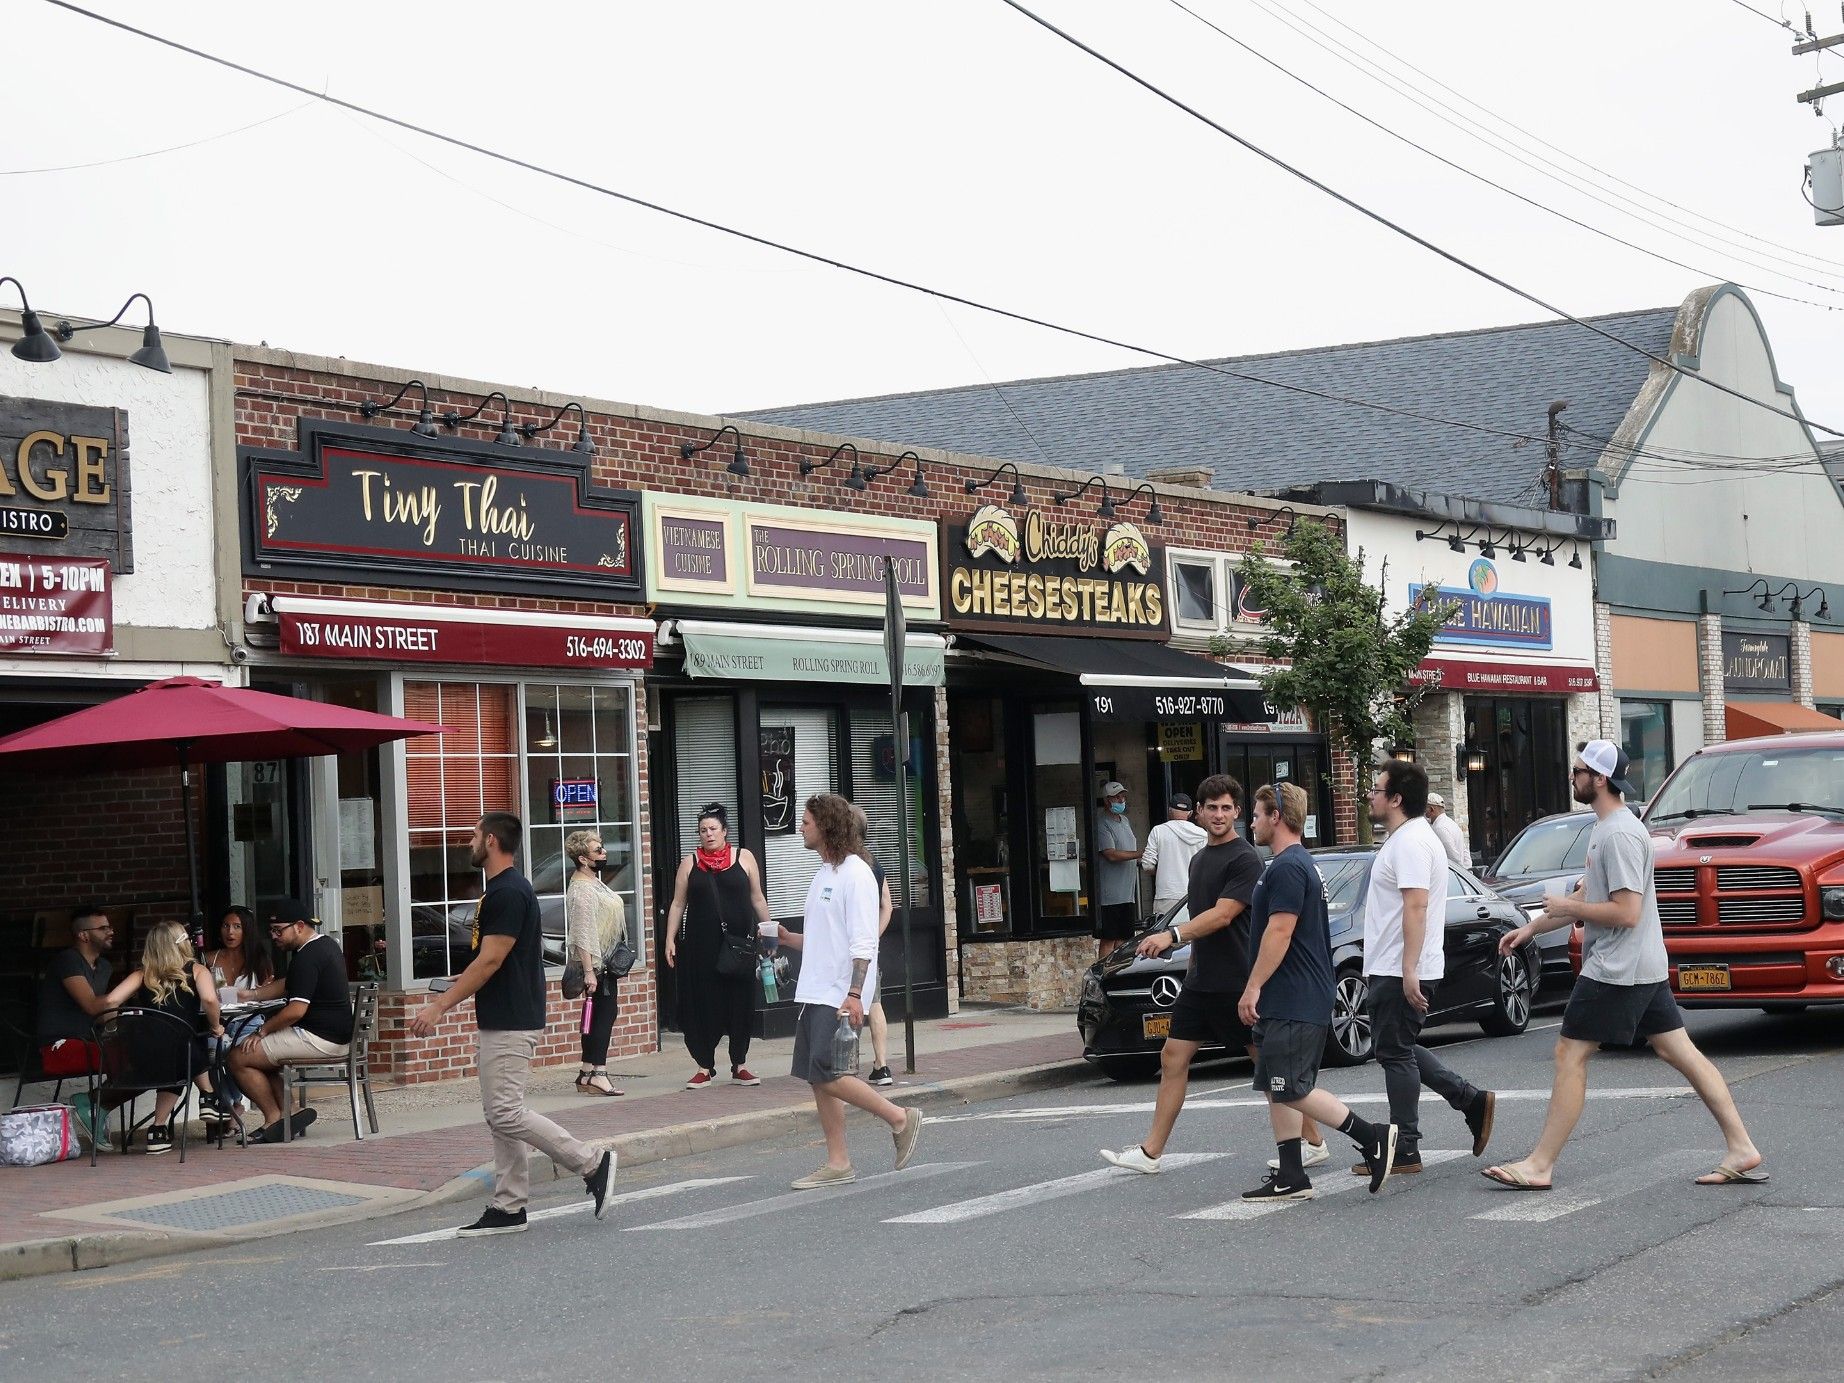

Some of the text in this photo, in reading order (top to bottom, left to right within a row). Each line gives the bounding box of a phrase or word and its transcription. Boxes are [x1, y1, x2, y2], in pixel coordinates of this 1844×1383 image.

[351, 470, 534, 546] Tiny Thai
[663, 525, 721, 550] VIETNAMESE
[754, 529, 769, 543] THE
[1025, 508, 1099, 573] Chiddy's
[459, 538, 568, 564] THAI CUISINE
[675, 553, 712, 575] CUISINE
[756, 545, 825, 577] ROLLING
[831, 551, 883, 582] SPRING
[41, 565, 105, 592] 5-10PM
[952, 566, 1162, 626] CHEESESTEAKS
[1471, 600, 1540, 633] HAWAIIAN
[19, 636, 51, 645] STREET
[296, 622, 439, 651] 187 MAIN STREET
[566, 635, 646, 660] 516-694-3302
[731, 656, 764, 670] STREET
[792, 657, 880, 675] ROLLING SPRING ROLL
[1094, 696, 1113, 714] 191
[1155, 696, 1224, 715] 516-927-8770
[1263, 701, 1278, 714] 19
[1165, 726, 1193, 738] OPEN
[555, 784, 597, 803] OPEN
